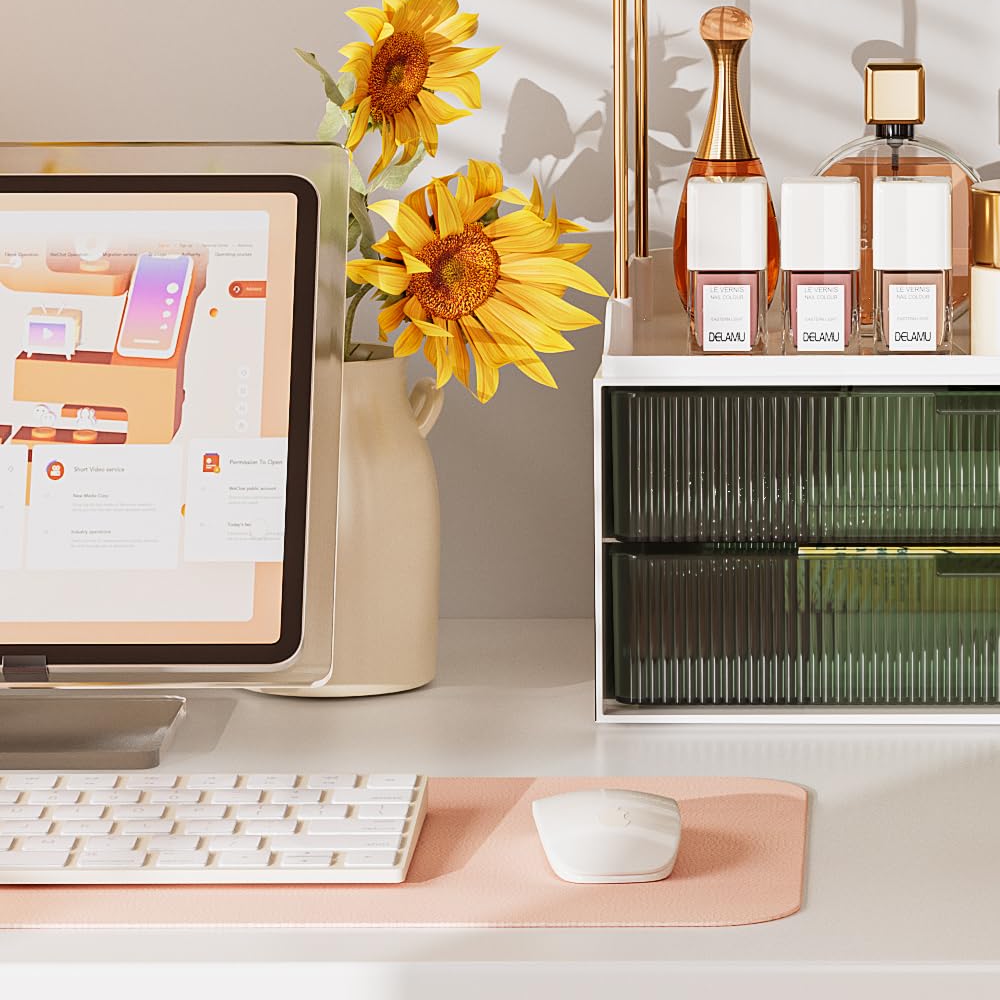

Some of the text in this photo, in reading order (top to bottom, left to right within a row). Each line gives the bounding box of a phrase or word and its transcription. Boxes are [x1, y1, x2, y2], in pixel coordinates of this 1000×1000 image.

[708, 331, 746, 343] DELAMU
[803, 331, 840, 343] DELAMU
[894, 331, 932, 343] DELAMU
